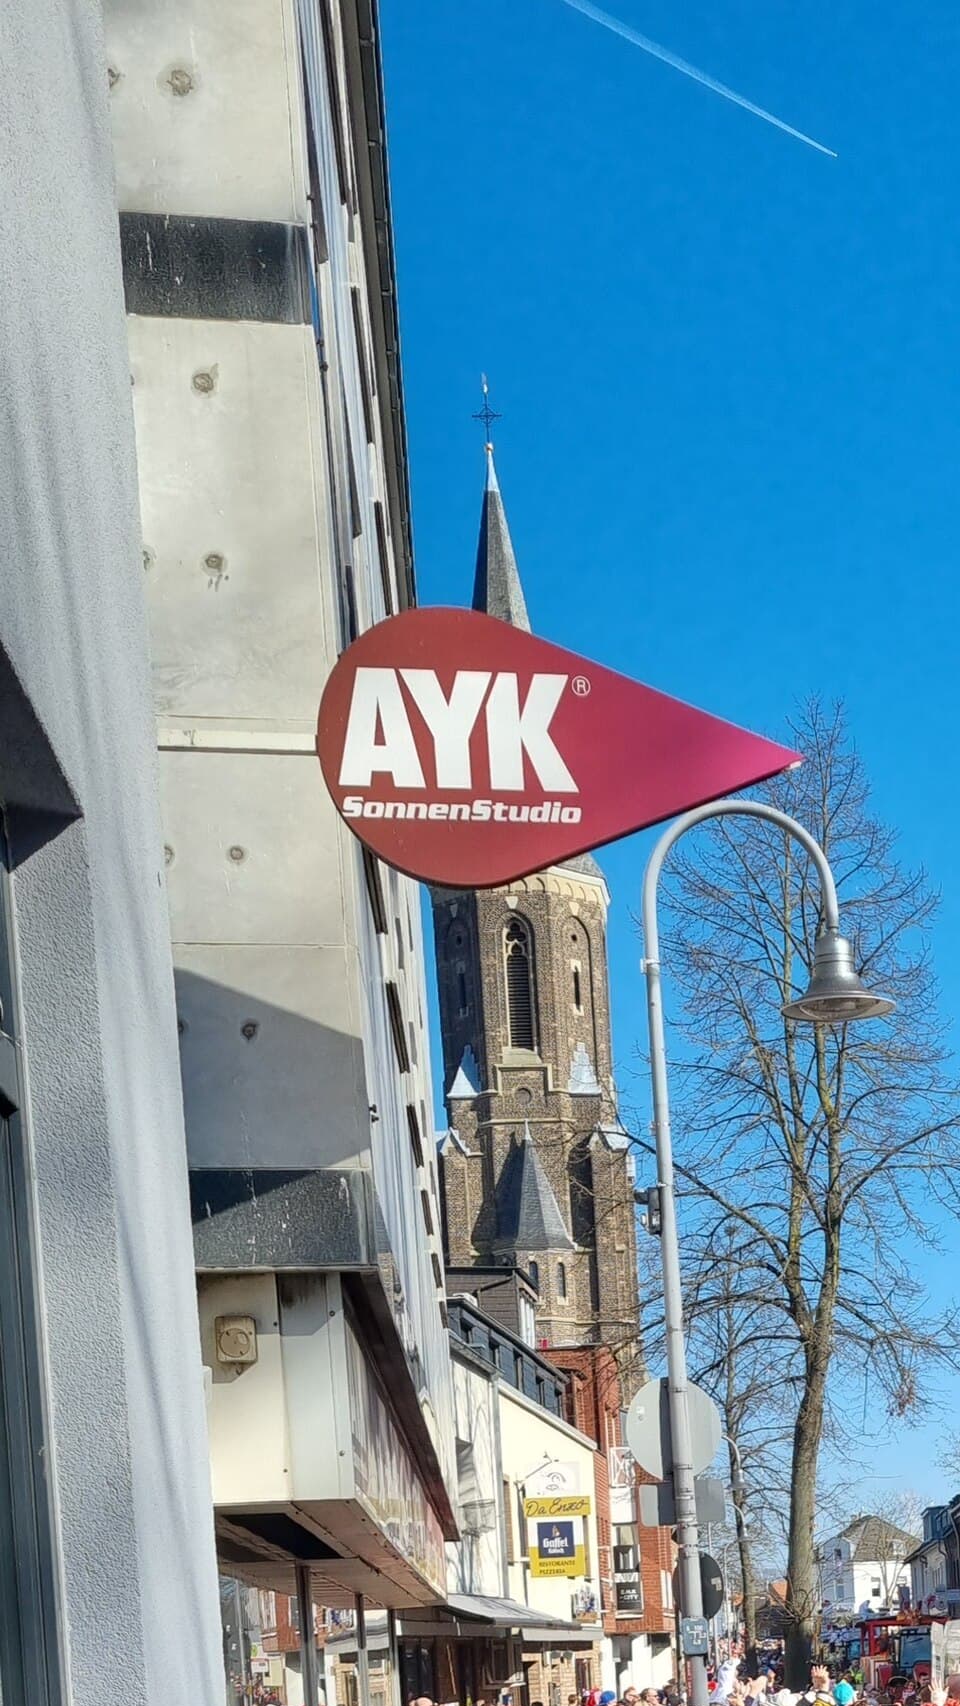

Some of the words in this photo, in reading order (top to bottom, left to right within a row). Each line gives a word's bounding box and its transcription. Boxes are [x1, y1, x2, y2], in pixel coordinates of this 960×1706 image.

[341, 795, 583, 824] SonnenStudio
[526, 1500, 547, 1517] Da
[549, 1497, 589, 1515] Enzo
